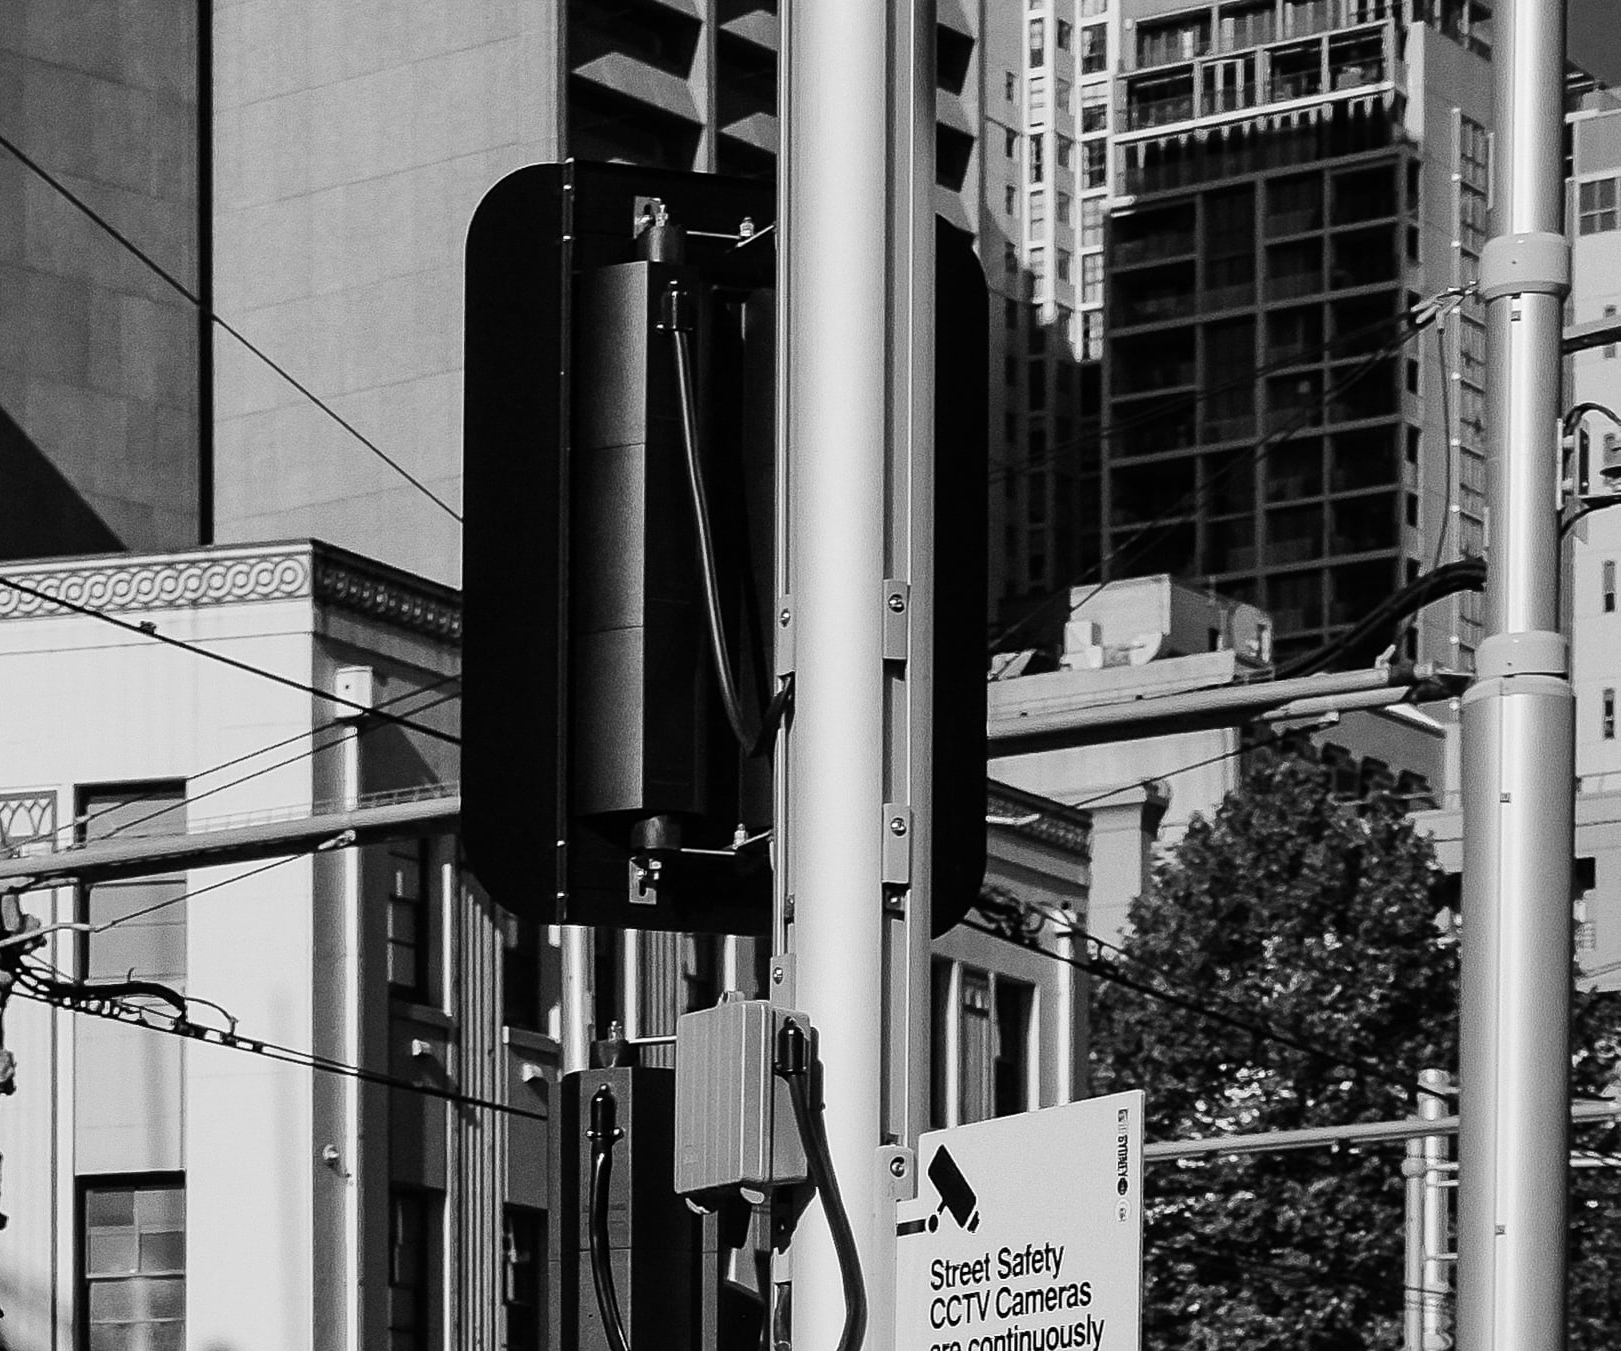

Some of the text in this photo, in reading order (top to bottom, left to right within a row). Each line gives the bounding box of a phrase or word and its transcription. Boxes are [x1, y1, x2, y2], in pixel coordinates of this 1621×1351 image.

[930, 1242, 1065, 1291] Street Safety
[930, 1281, 1092, 1330] CCTV Cameras
